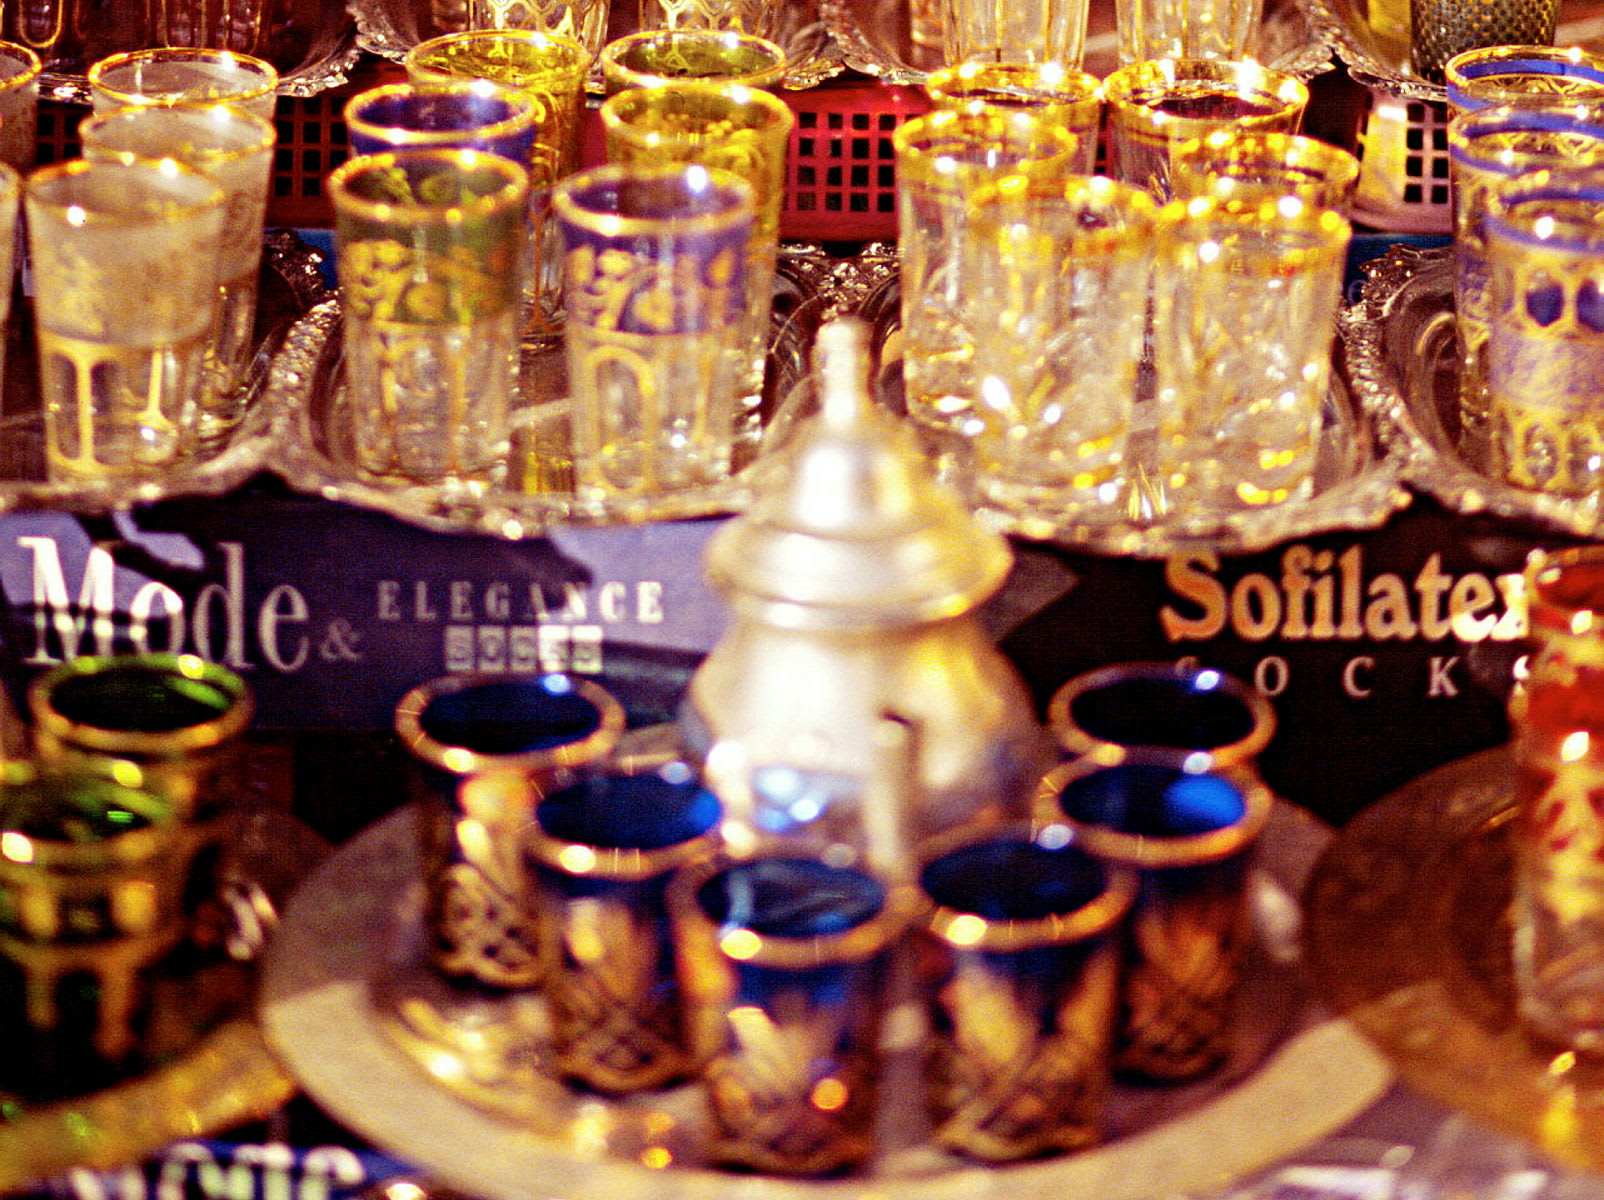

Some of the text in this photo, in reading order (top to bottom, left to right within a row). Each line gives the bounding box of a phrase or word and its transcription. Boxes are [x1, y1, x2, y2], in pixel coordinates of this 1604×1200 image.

[17, 536, 664, 672] Mode & ELEGANCE
